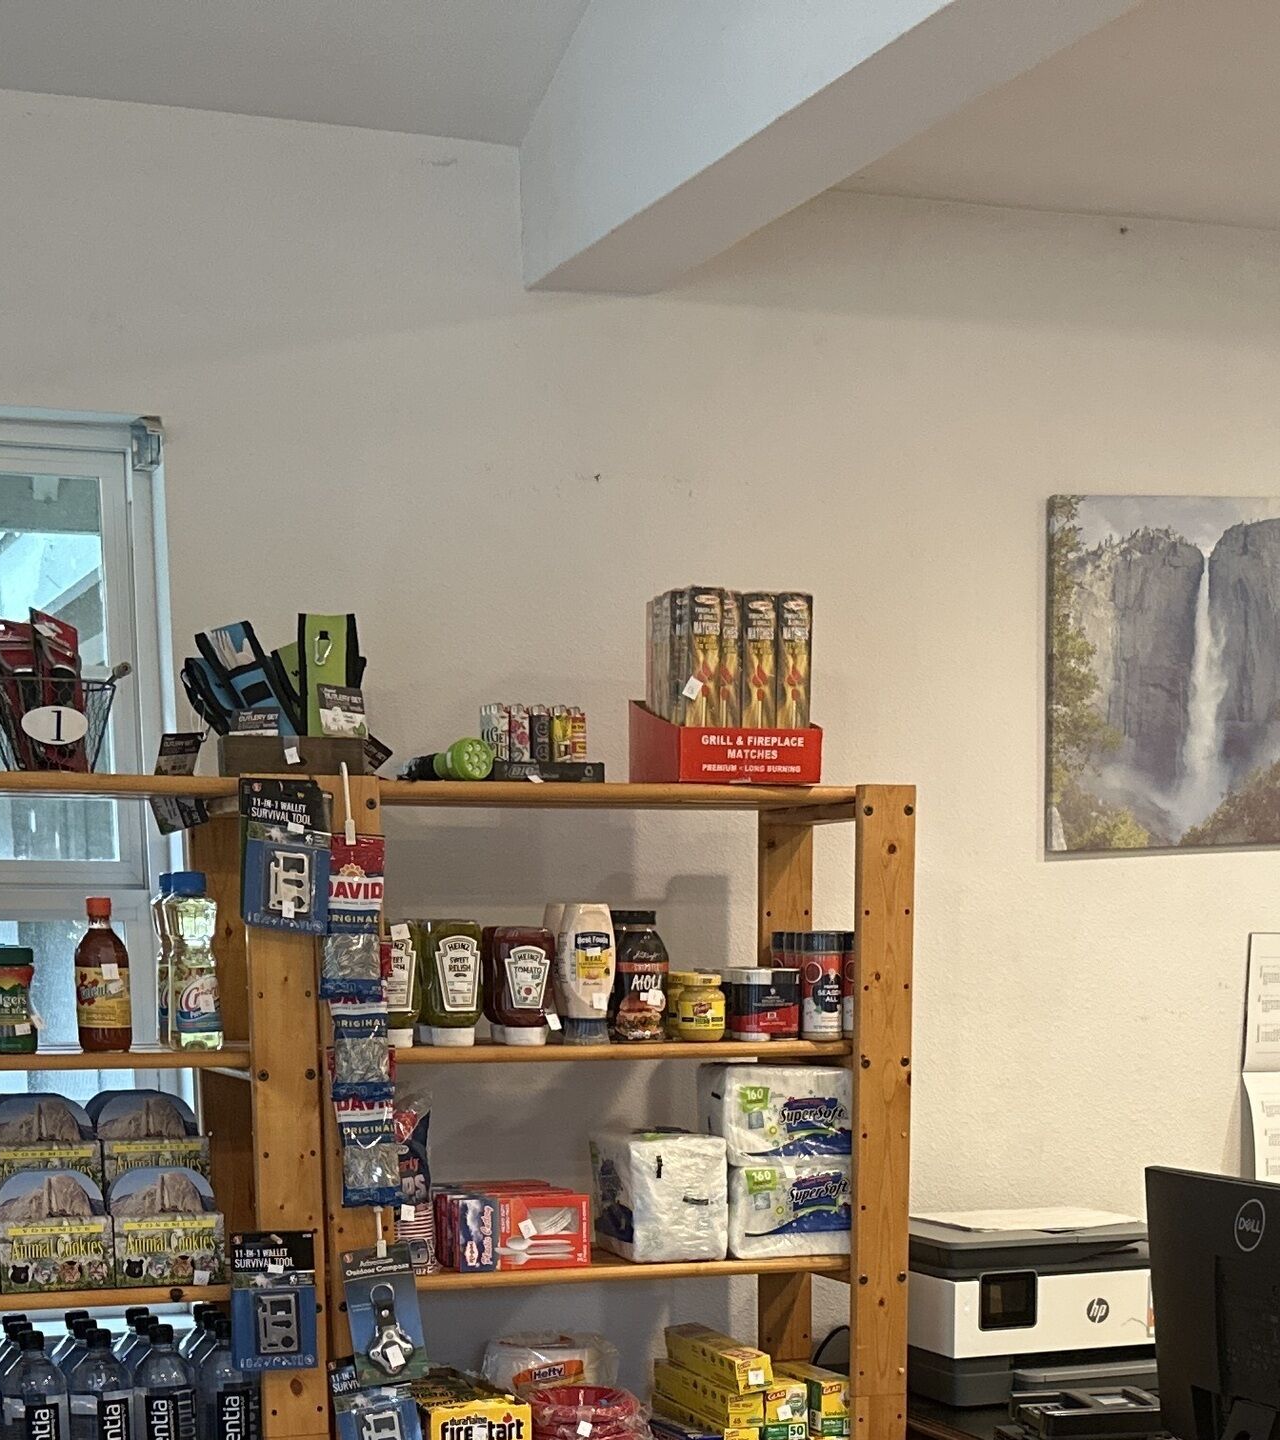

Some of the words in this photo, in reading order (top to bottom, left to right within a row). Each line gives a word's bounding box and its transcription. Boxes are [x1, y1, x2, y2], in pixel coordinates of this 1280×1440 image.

[52, 711, 64, 742] 1
[701, 735, 731, 746] GRILL
[735, 735, 744, 745] &
[747, 736, 805, 748] FIREPLACE
[727, 749, 778, 760] MATCHES
[744, 764, 765, 772] LONG
[767, 765, 801, 773] BURNING
[252, 797, 278, 809] 11-IN-1
[280, 802, 307, 813] WALLET
[251, 807, 289, 822] SURVIVAL
[292, 814, 311, 826] TOOL
[576, 936, 591, 945] Best
[592, 936, 609, 945] Foods
[447, 942, 470, 952] HEINZ
[449, 956, 469, 964] SWEET
[517, 954, 539, 962] HEINZ
[448, 963, 471, 972] RELISH
[513, 966, 543, 974] TOMATO
[746, 1089, 764, 1100] 160
[751, 1170, 771, 1181] 160
[22, 1226, 91, 1234] YOSEMITE
[11, 1239, 54, 1261] Animal
[57, 1238, 104, 1259] Cookies
[125, 1234, 167, 1255] Animal
[170, 1233, 216, 1254] Cookies
[234, 1258, 272, 1269] SURVIVAL
[275, 1257, 295, 1267] TOOL
[1089, 1298, 1108, 1323] hp
[533, 1367, 563, 1380] Hefty
[789, 1426, 804, 1436] 50
